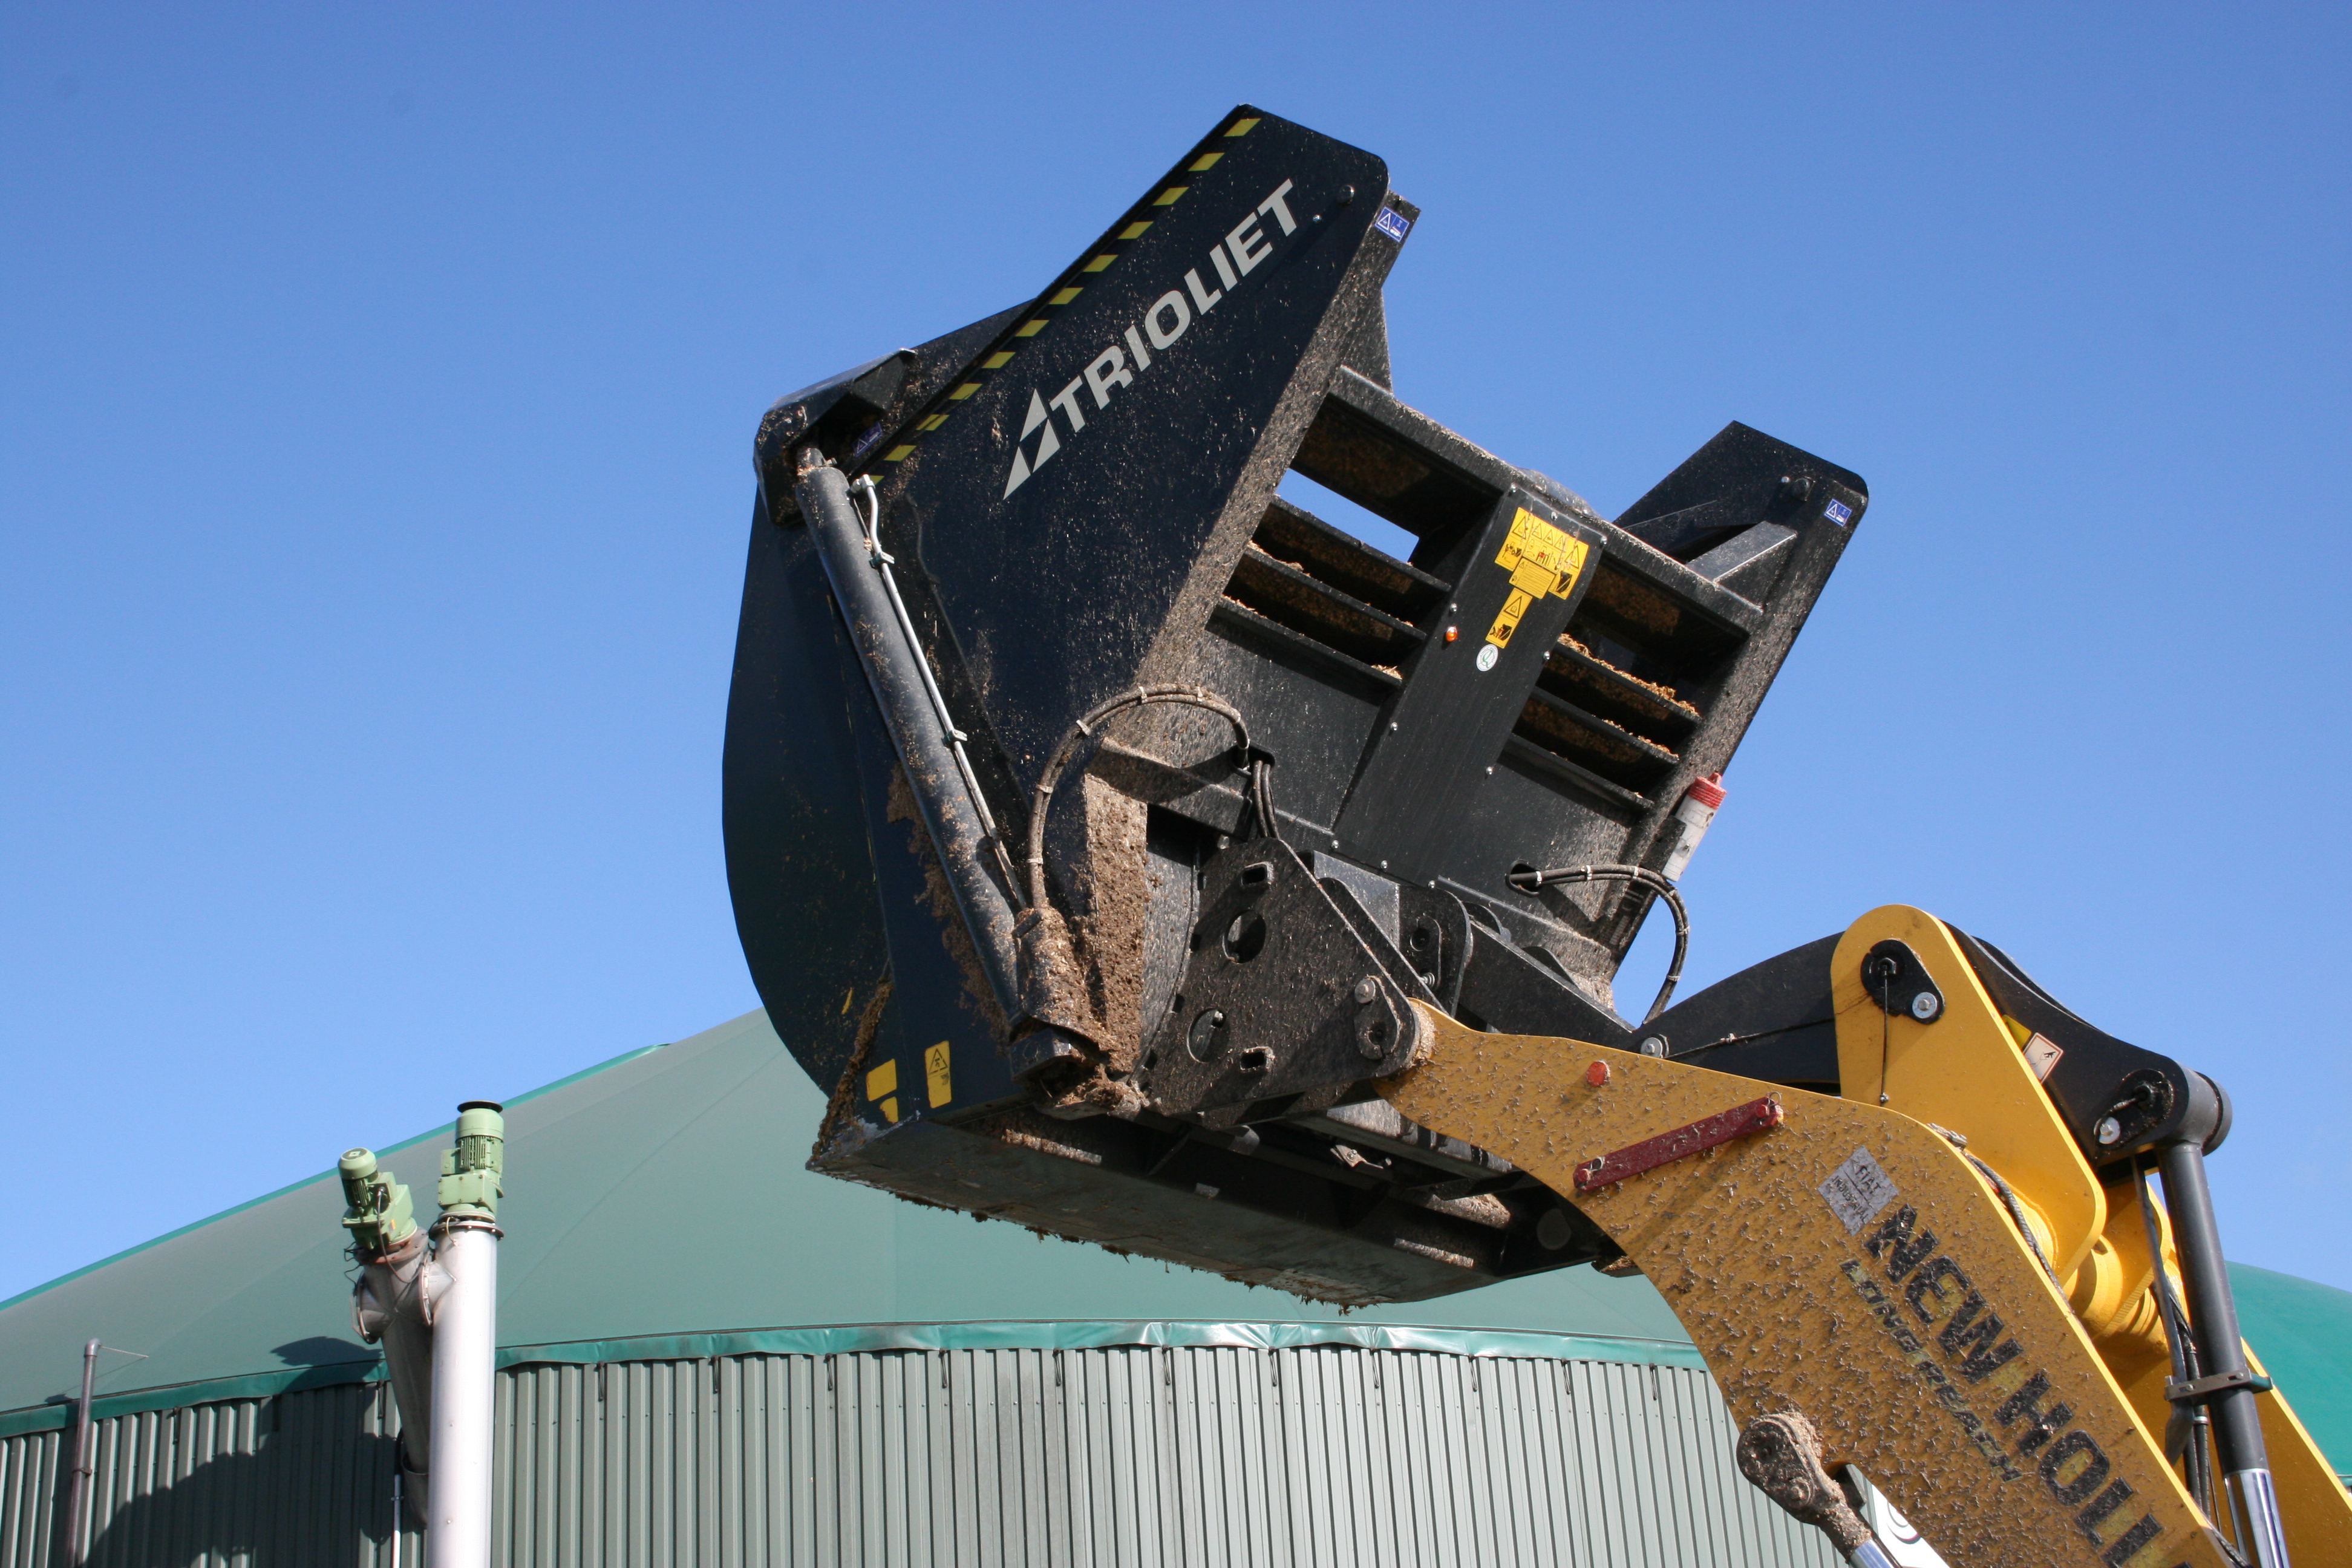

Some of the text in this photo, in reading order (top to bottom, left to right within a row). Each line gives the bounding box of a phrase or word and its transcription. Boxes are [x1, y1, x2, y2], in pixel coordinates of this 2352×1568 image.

[1050, 178, 1297, 433] TRIOLIET
[1832, 1175, 1869, 1221] INDUSTRIAL
[1855, 1165, 1881, 1195] FIAT
[1840, 1261, 2022, 1482] LONG REACH
[1864, 1203, 2194, 1568] NEW HOLL
